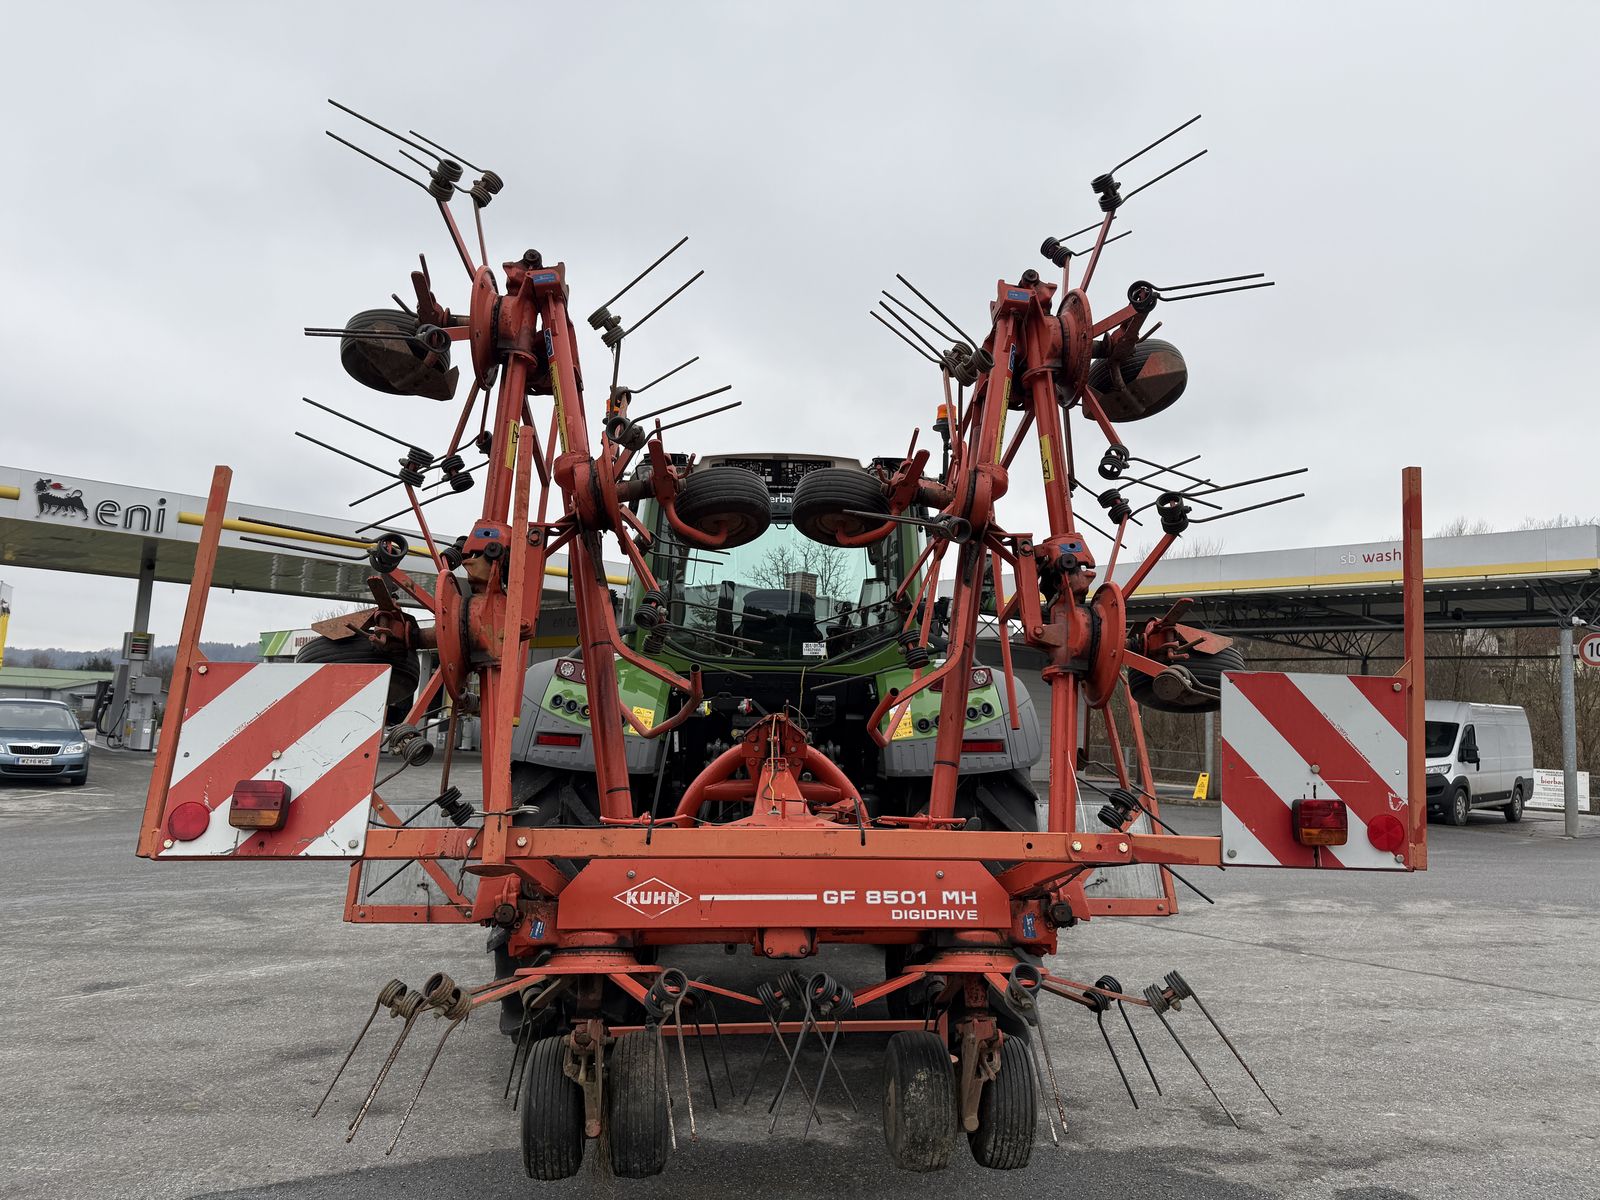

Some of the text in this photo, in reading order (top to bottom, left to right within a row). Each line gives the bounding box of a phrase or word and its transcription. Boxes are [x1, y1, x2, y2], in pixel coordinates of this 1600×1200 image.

[770, 492, 793, 503] erba
[95, 498, 167, 533] eni
[1340, 548, 1402, 565] sb wash
[626, 891, 680, 905] KUHN
[822, 890, 978, 905] GF 8501 MH
[891, 909, 979, 920] DIGIDRIVE
